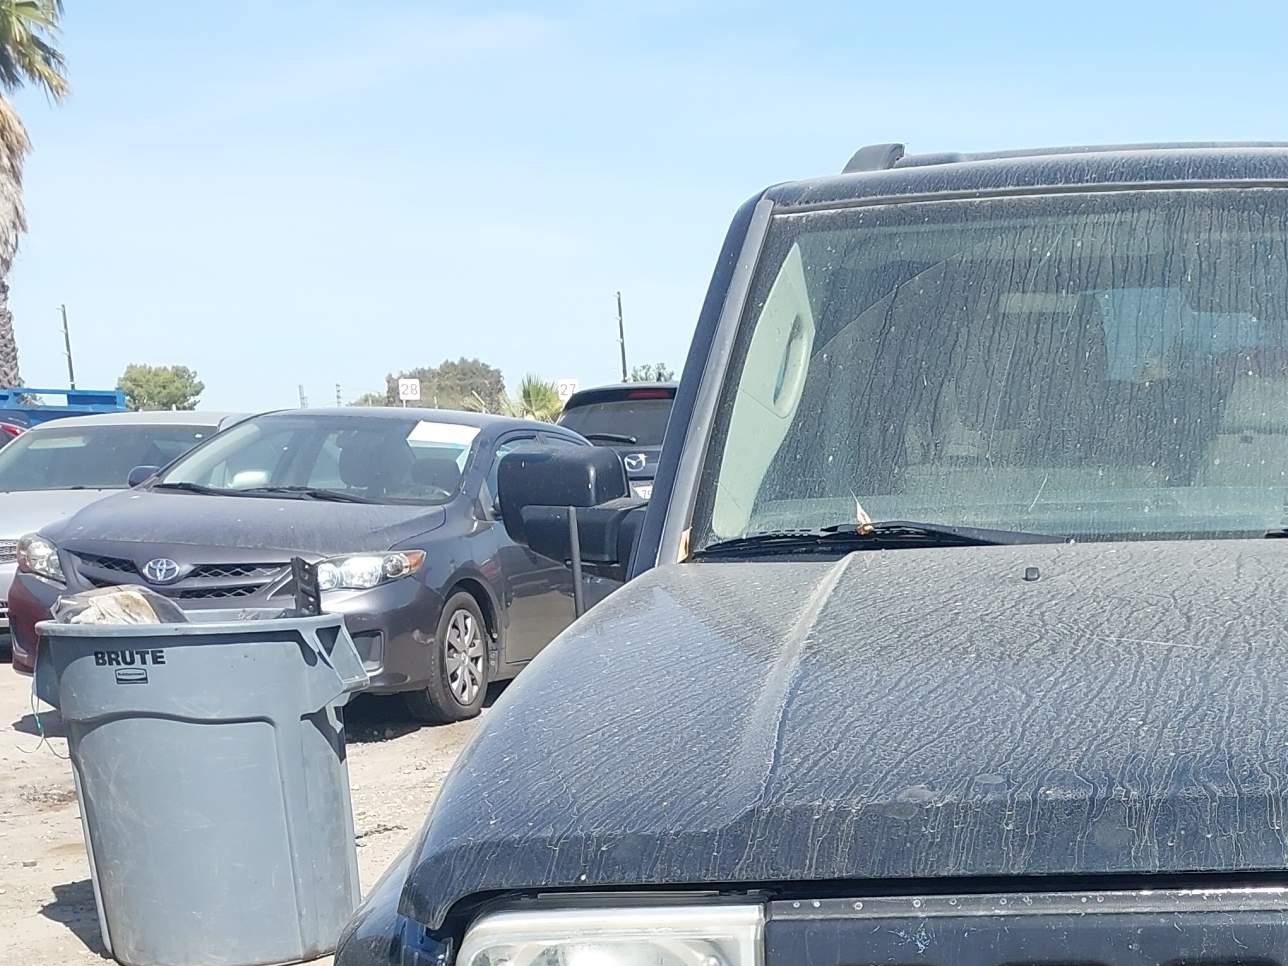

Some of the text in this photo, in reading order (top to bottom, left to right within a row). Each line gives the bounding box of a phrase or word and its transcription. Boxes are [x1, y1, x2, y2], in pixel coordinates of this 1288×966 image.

[401, 383, 418, 395] 28
[559, 383, 576, 396] 27
[94, 650, 166, 666] BRUTE
